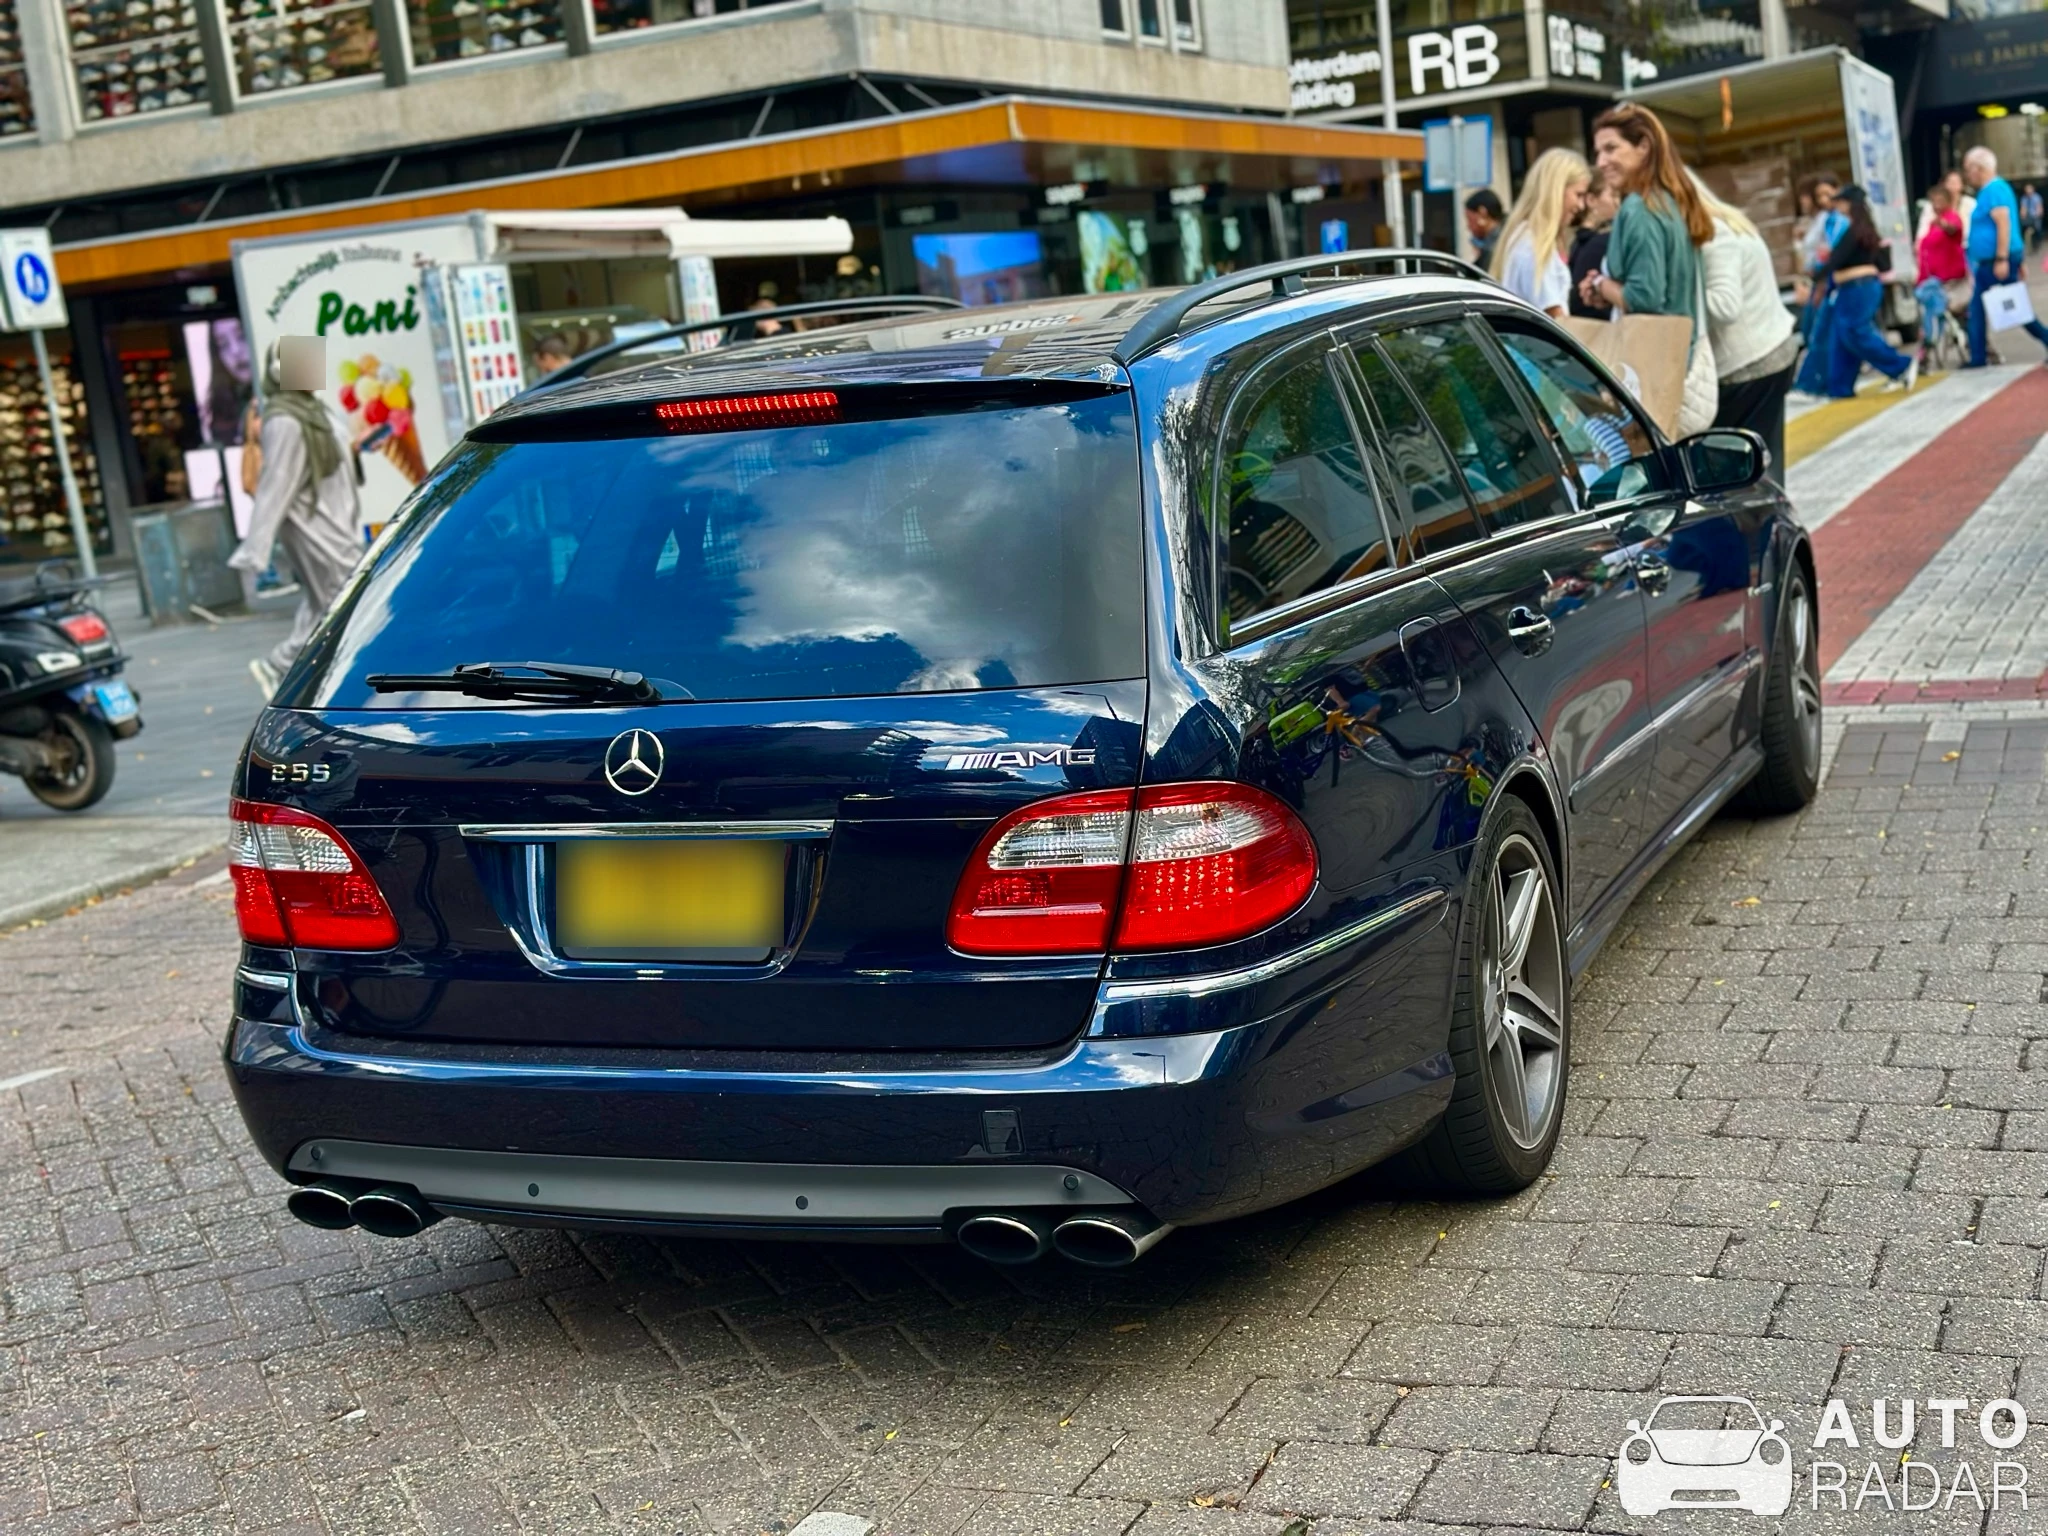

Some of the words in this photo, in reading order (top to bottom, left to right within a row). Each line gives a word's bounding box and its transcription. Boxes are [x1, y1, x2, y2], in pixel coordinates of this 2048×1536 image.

[1408, 24, 1499, 95] RB
[316, 284, 421, 337] Pani
[271, 763, 331, 782] E55
[990, 748, 1097, 768] AMG
